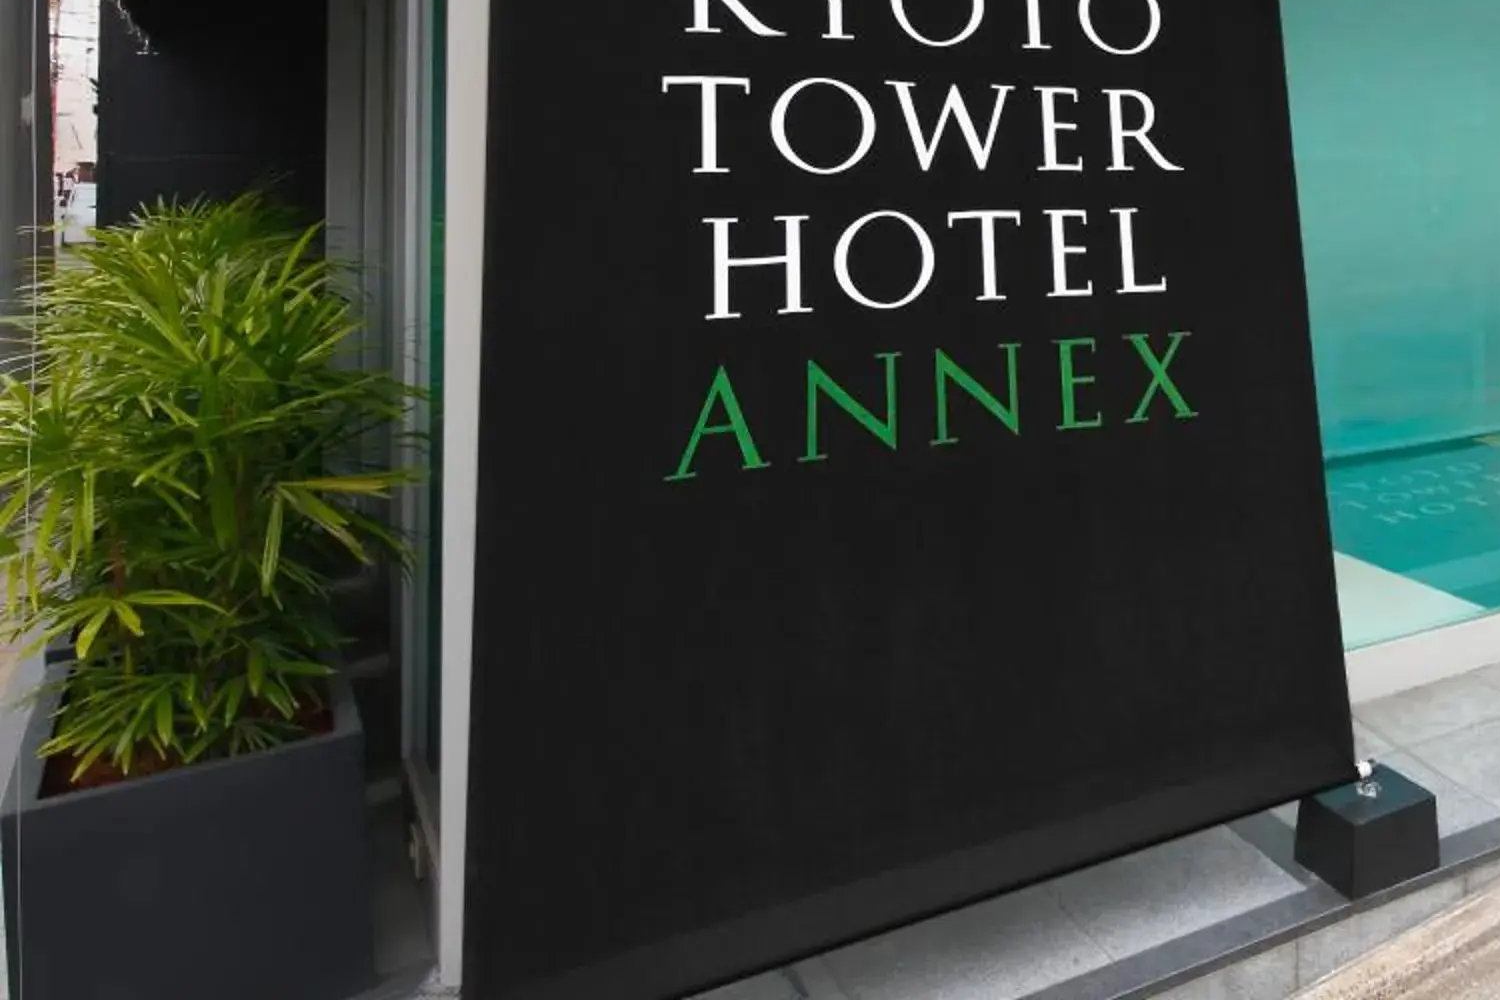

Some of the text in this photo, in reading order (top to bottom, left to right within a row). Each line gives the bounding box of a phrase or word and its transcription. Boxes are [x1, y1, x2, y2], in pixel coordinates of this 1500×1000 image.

[662, 75, 1184, 174] TOWER
[702, 207, 1167, 320] HOTEL
[664, 330, 1199, 482] ANNEX
